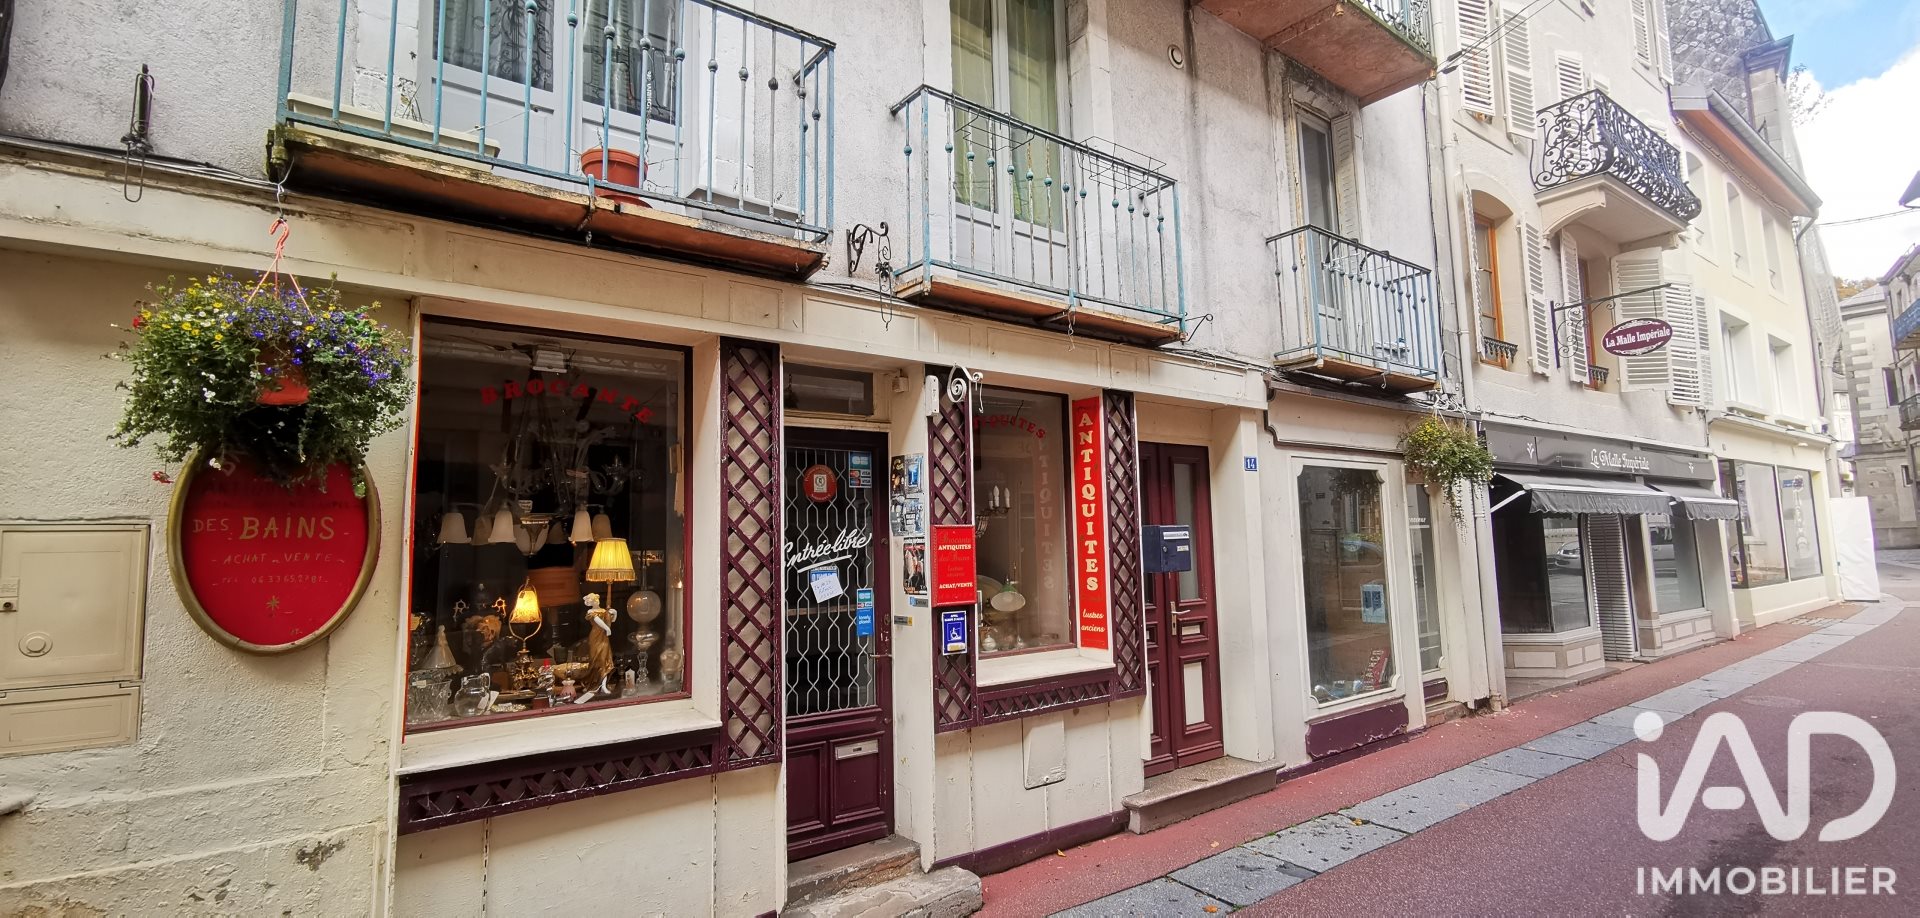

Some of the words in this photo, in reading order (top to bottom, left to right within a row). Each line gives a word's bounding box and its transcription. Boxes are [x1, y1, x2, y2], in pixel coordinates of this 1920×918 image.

[1605, 337, 1615, 348] La
[1616, 333, 1636, 346] Malle
[1636, 326, 1671, 343] Impériale
[480, 379, 656, 424] BROCANTE
[1247, 458, 1255, 469] 14
[1590, 448, 1600, 469] La
[1599, 450, 1622, 467] Malle
[1078, 412, 1099, 591] ANTIQUITES
[192, 518, 230, 533] DES
[239, 514, 335, 540] BAINS
[224, 553, 268, 565] ACHAT
[284, 552, 333, 563] VENTE
[1082, 609, 1104, 620] lustres
[1081, 625, 1105, 633] anciens
